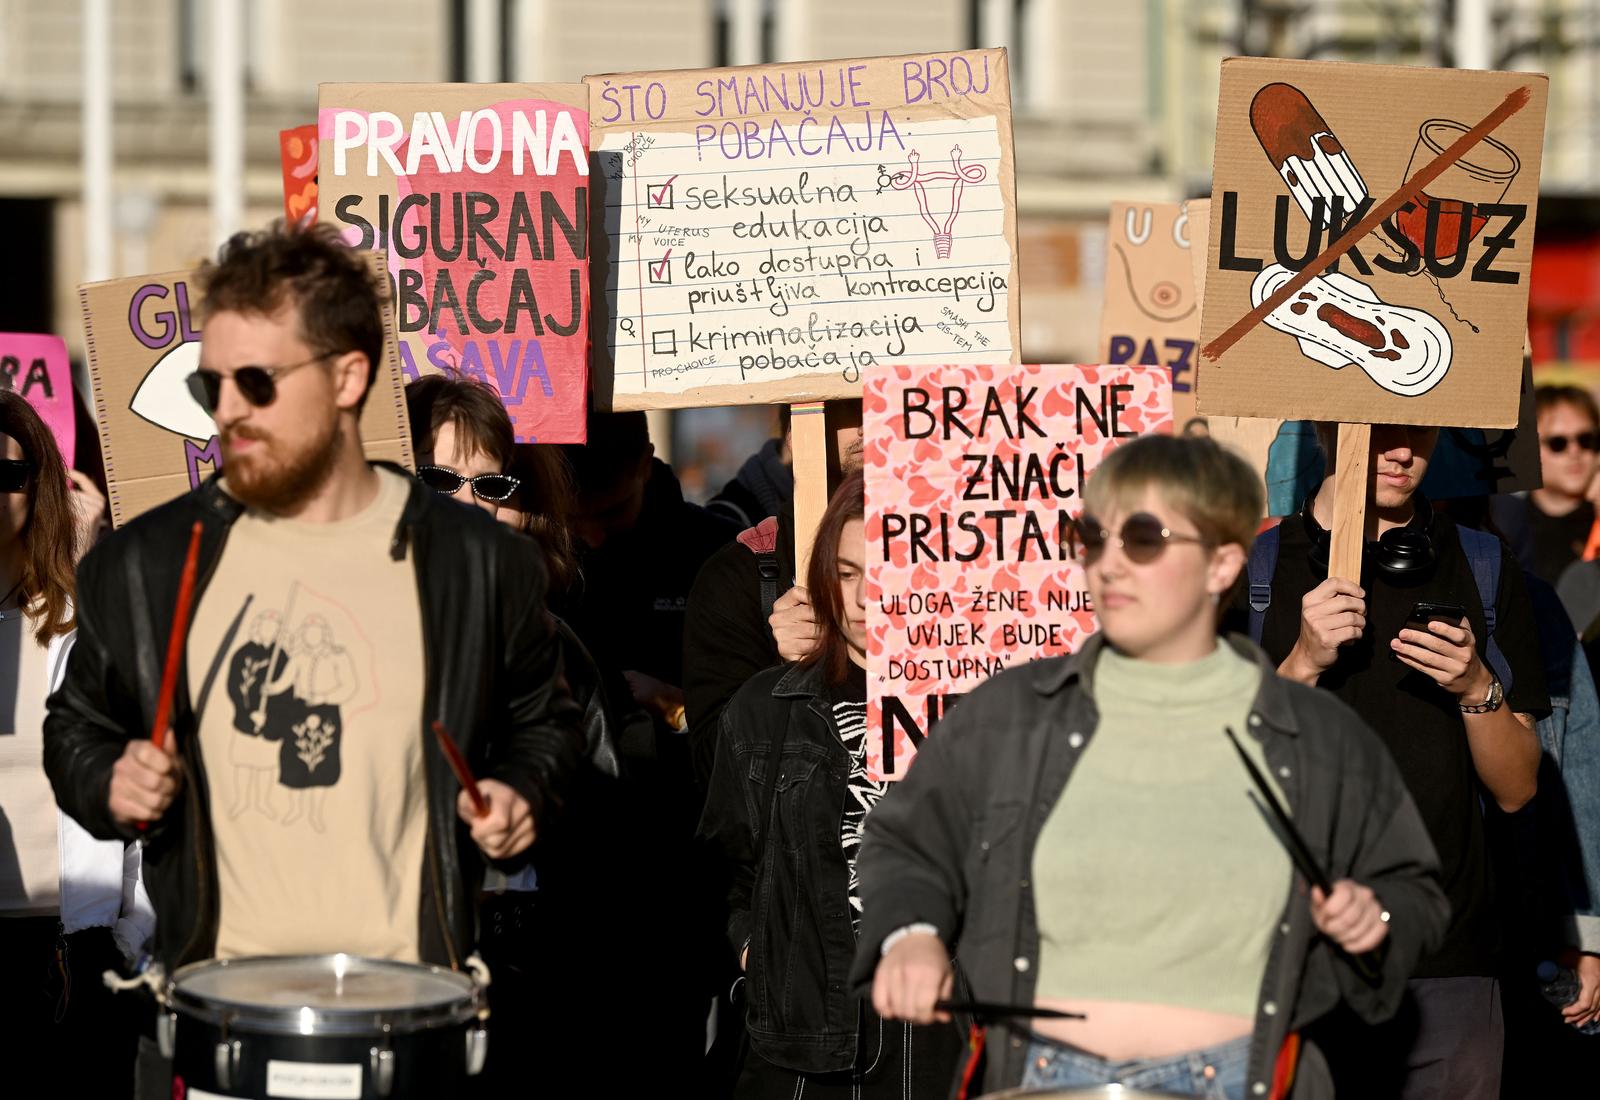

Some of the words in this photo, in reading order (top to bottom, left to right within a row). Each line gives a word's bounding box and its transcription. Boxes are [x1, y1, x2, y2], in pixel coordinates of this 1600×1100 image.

[601, 80, 667, 123] ŠTO
[695, 65, 871, 117] SMANJUJE
[903, 55, 990, 104] BROJ
[334, 108, 502, 177] PRAVO
[512, 109, 590, 177] NA
[627, 136, 656, 167] CHOICE
[697, 110, 912, 162] POBAČAJA:
[685, 171, 858, 210] seksualna
[334, 187, 588, 263] SIGURAN
[653, 237, 686, 247] VOICE
[658, 223, 710, 238] UTERUS
[732, 211, 889, 255] edukacija
[1218, 191, 1528, 285] LUKSUZ
[684, 251, 740, 280] lako
[759, 248, 890, 278] dostupna
[915, 246, 921, 267] i
[388, 258, 582, 337] BAČAJ
[845, 270, 1008, 312] kontracepcija
[688, 311, 924, 356] kriminalizacija
[940, 306, 969, 330] SMASH
[974, 330, 991, 347] THE
[652, 354, 717, 379] PRO-CHOICE
[739, 345, 880, 383] pobačaja
[902, 385, 1048, 441] BRAK
[1075, 384, 1139, 438] NE
[962, 442, 1085, 501] ZNAČI
[879, 591, 954, 615] ULOGA
[971, 586, 1028, 613] ŽENE
[1047, 590, 1094, 613] NIJE
[907, 623, 985, 646] UVIJEK
[1003, 623, 1062, 646] BUDE
